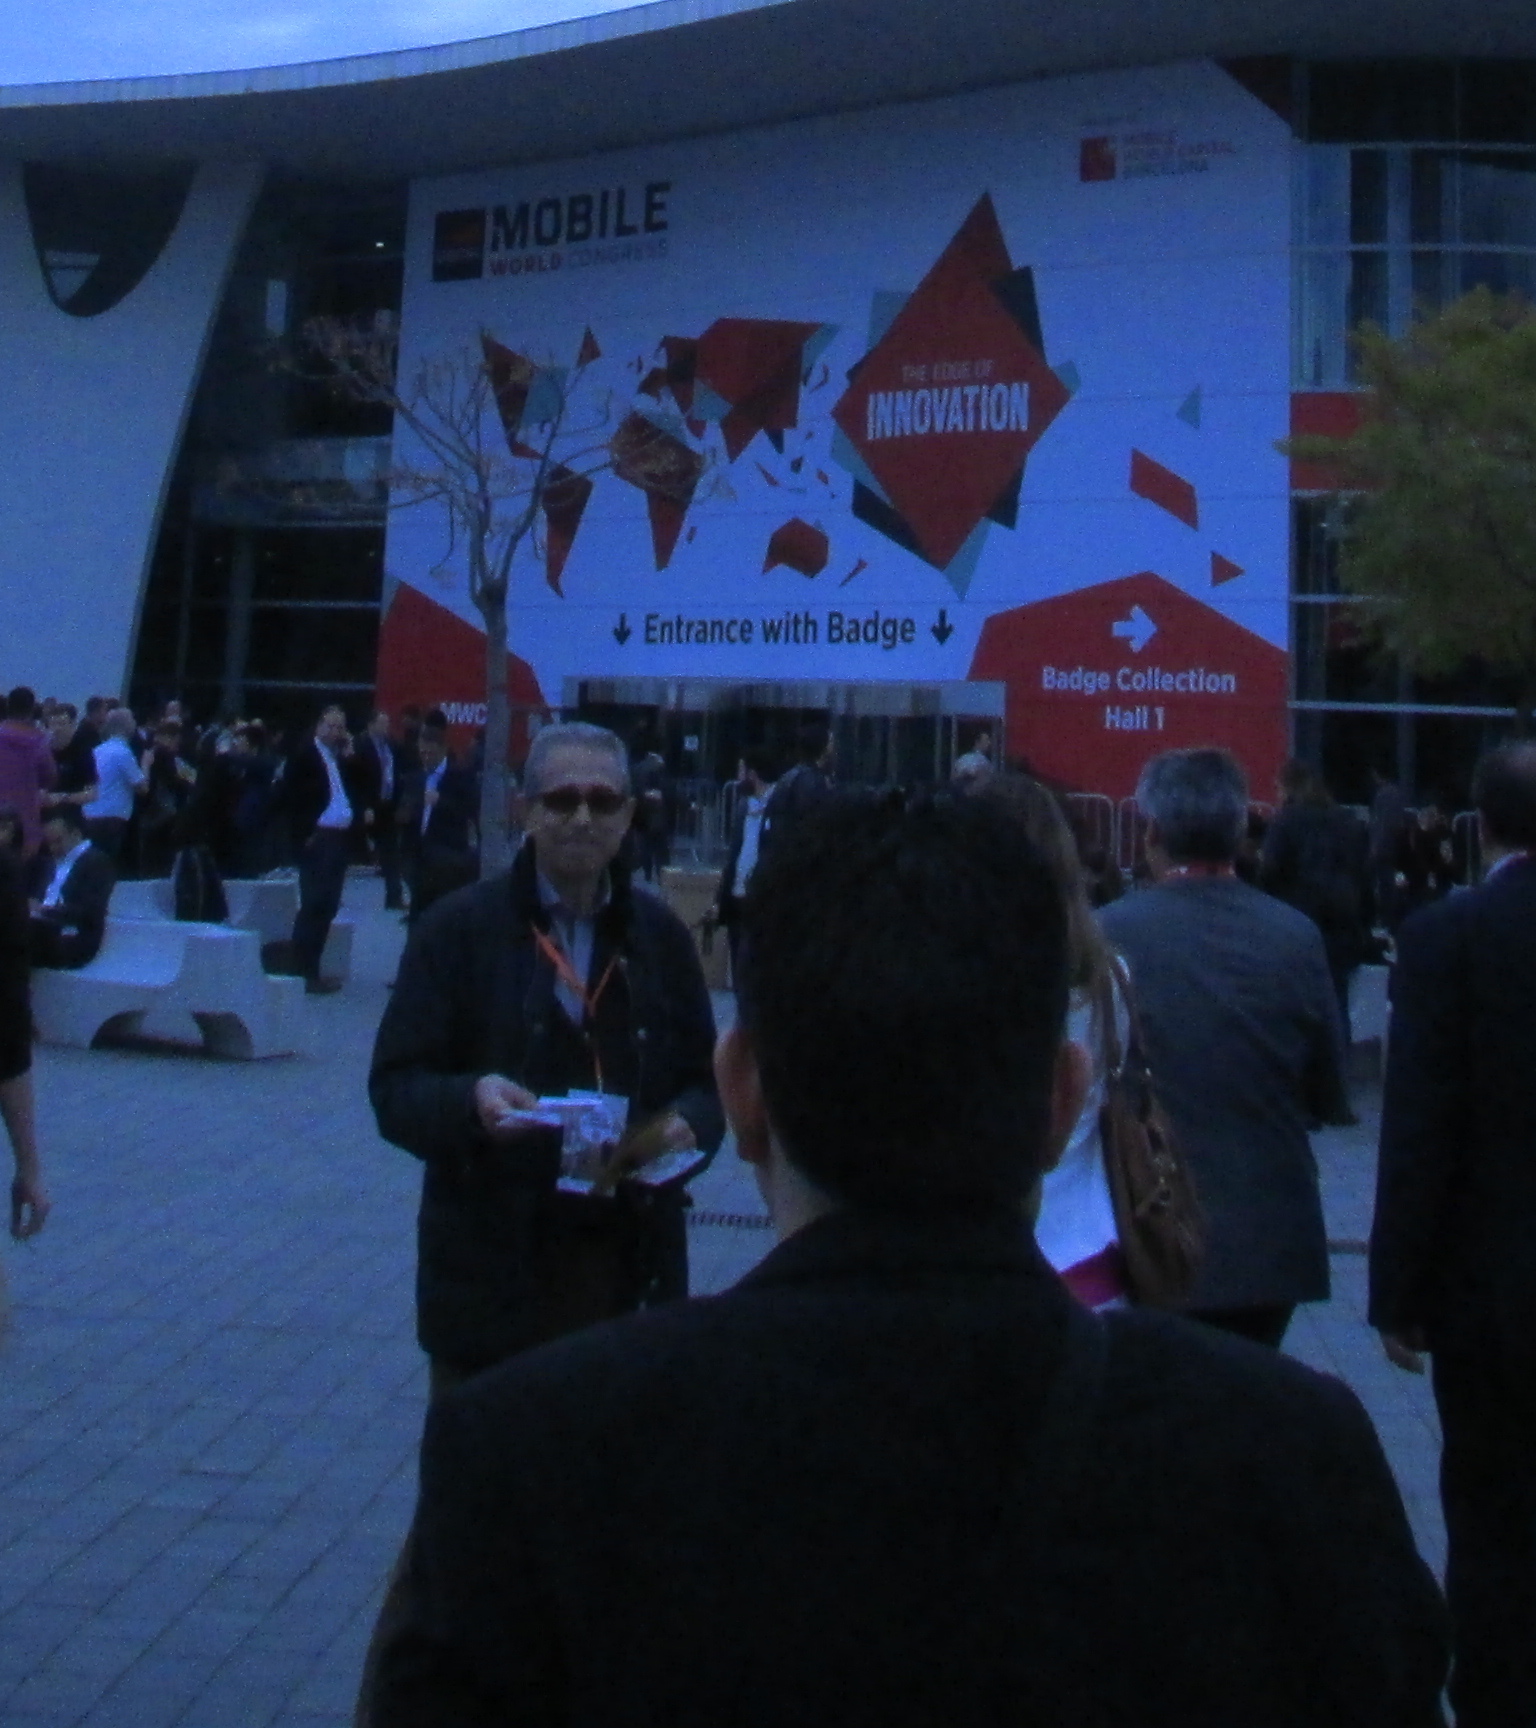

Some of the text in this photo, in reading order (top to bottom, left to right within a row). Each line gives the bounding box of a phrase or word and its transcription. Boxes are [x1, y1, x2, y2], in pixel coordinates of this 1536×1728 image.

[491, 181, 672, 251] MOBILE
[490, 251, 563, 276] WORLD
[901, 358, 995, 383] THE EDGE OF
[866, 381, 1030, 441] INNOVATION
[644, 611, 916, 650] Entrance with Badge
[1042, 665, 1236, 695] Badge Collection
[1104, 704, 1165, 730] Hall 1
